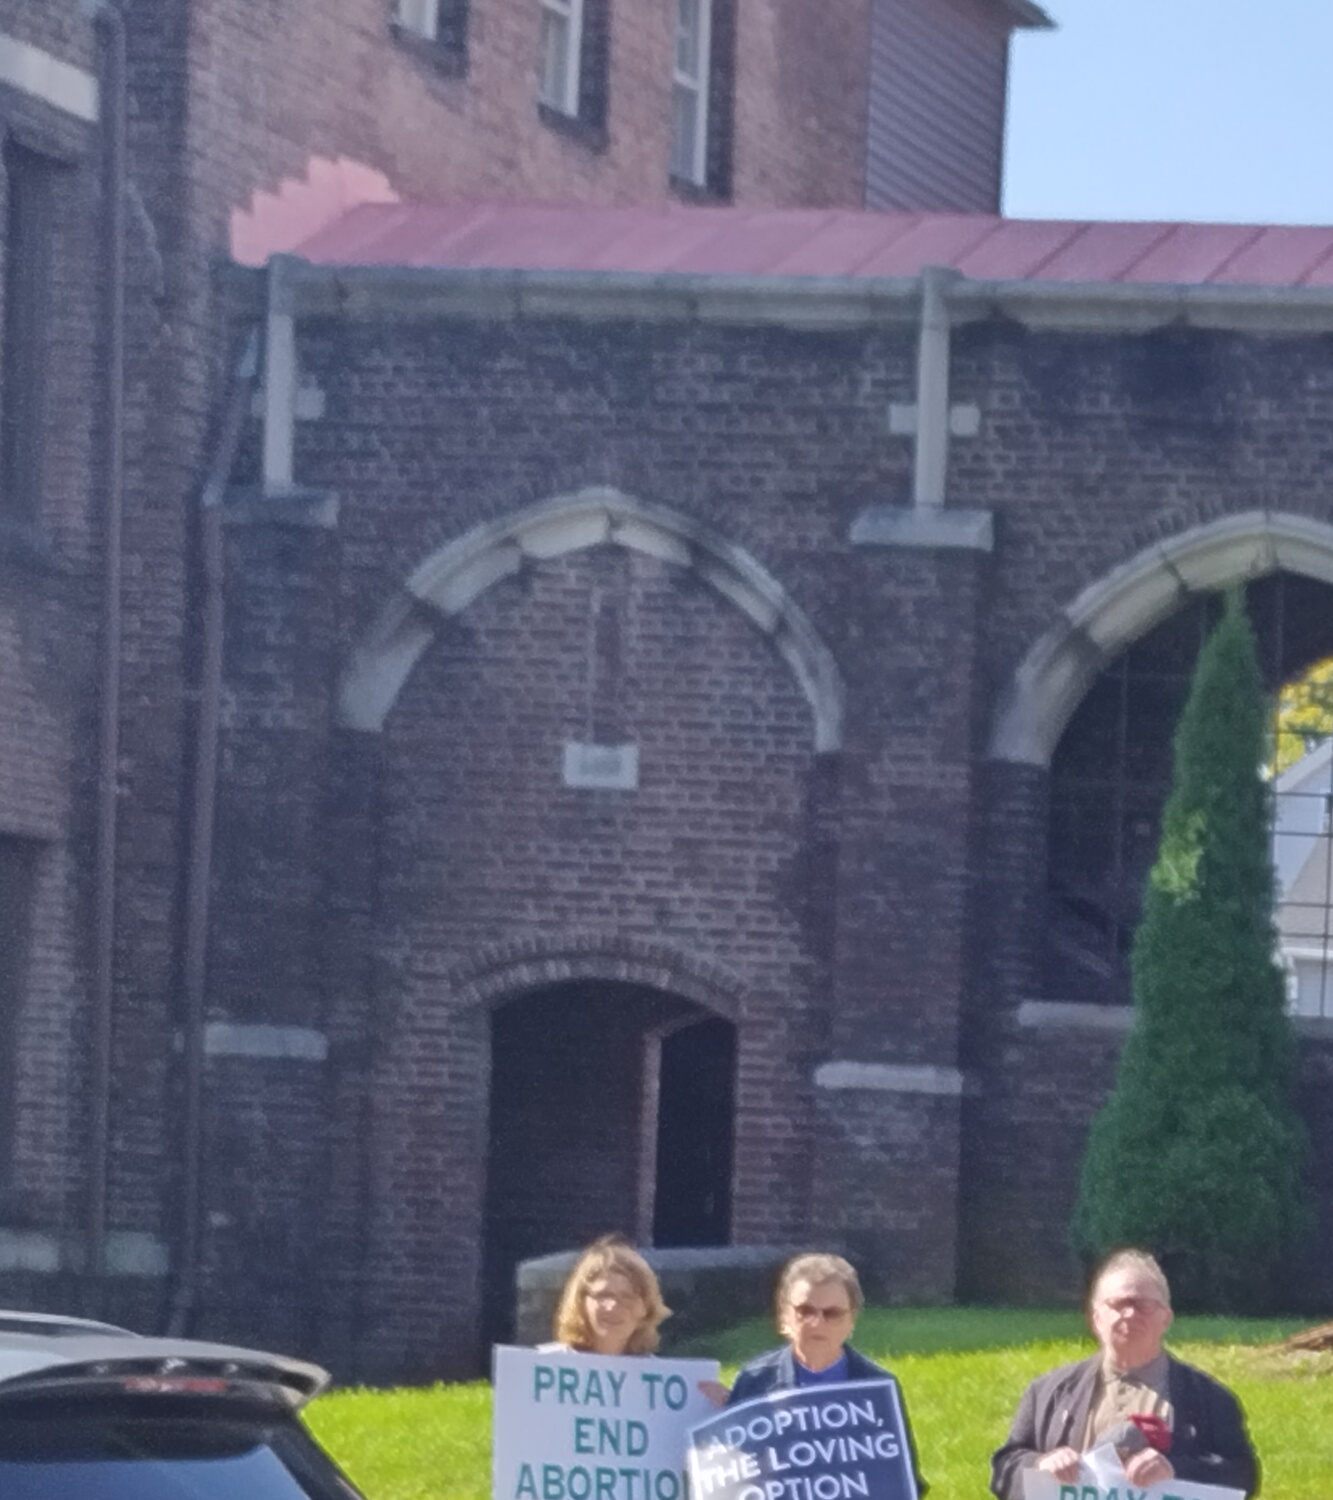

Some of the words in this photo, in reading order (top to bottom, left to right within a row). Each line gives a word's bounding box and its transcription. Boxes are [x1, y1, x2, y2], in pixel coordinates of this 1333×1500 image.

[534, 1366, 626, 1406] PRAY
[641, 1373, 688, 1410] TO
[574, 1418, 649, 1455] END
[702, 1450, 761, 1492] THE
[769, 1434, 899, 1471] LOVING
